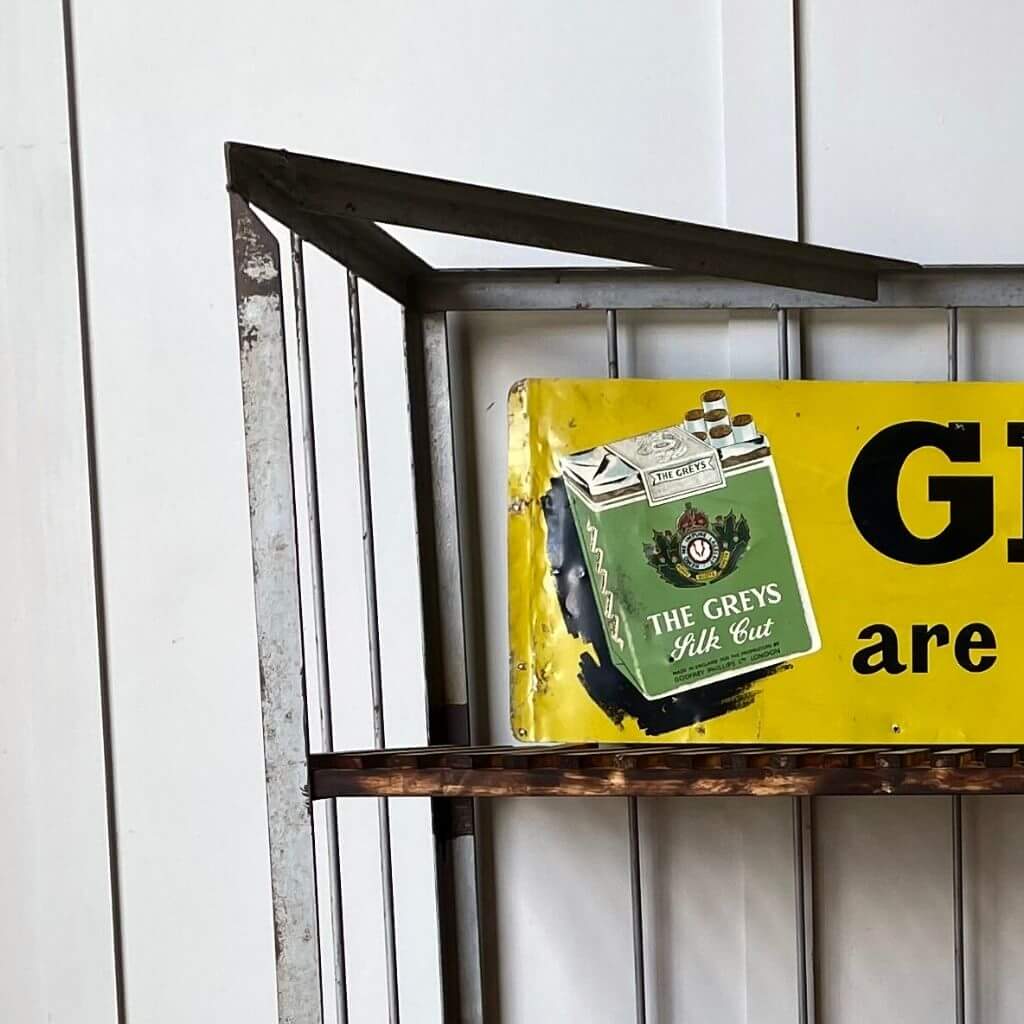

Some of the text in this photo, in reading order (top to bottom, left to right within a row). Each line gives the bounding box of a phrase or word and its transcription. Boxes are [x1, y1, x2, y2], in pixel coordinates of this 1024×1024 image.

[656, 461, 707, 482] THE GREYS
[647, 583, 782, 635] THE GREYS
[670, 616, 775, 661] Silk Cut
[852, 622, 998, 673] are
